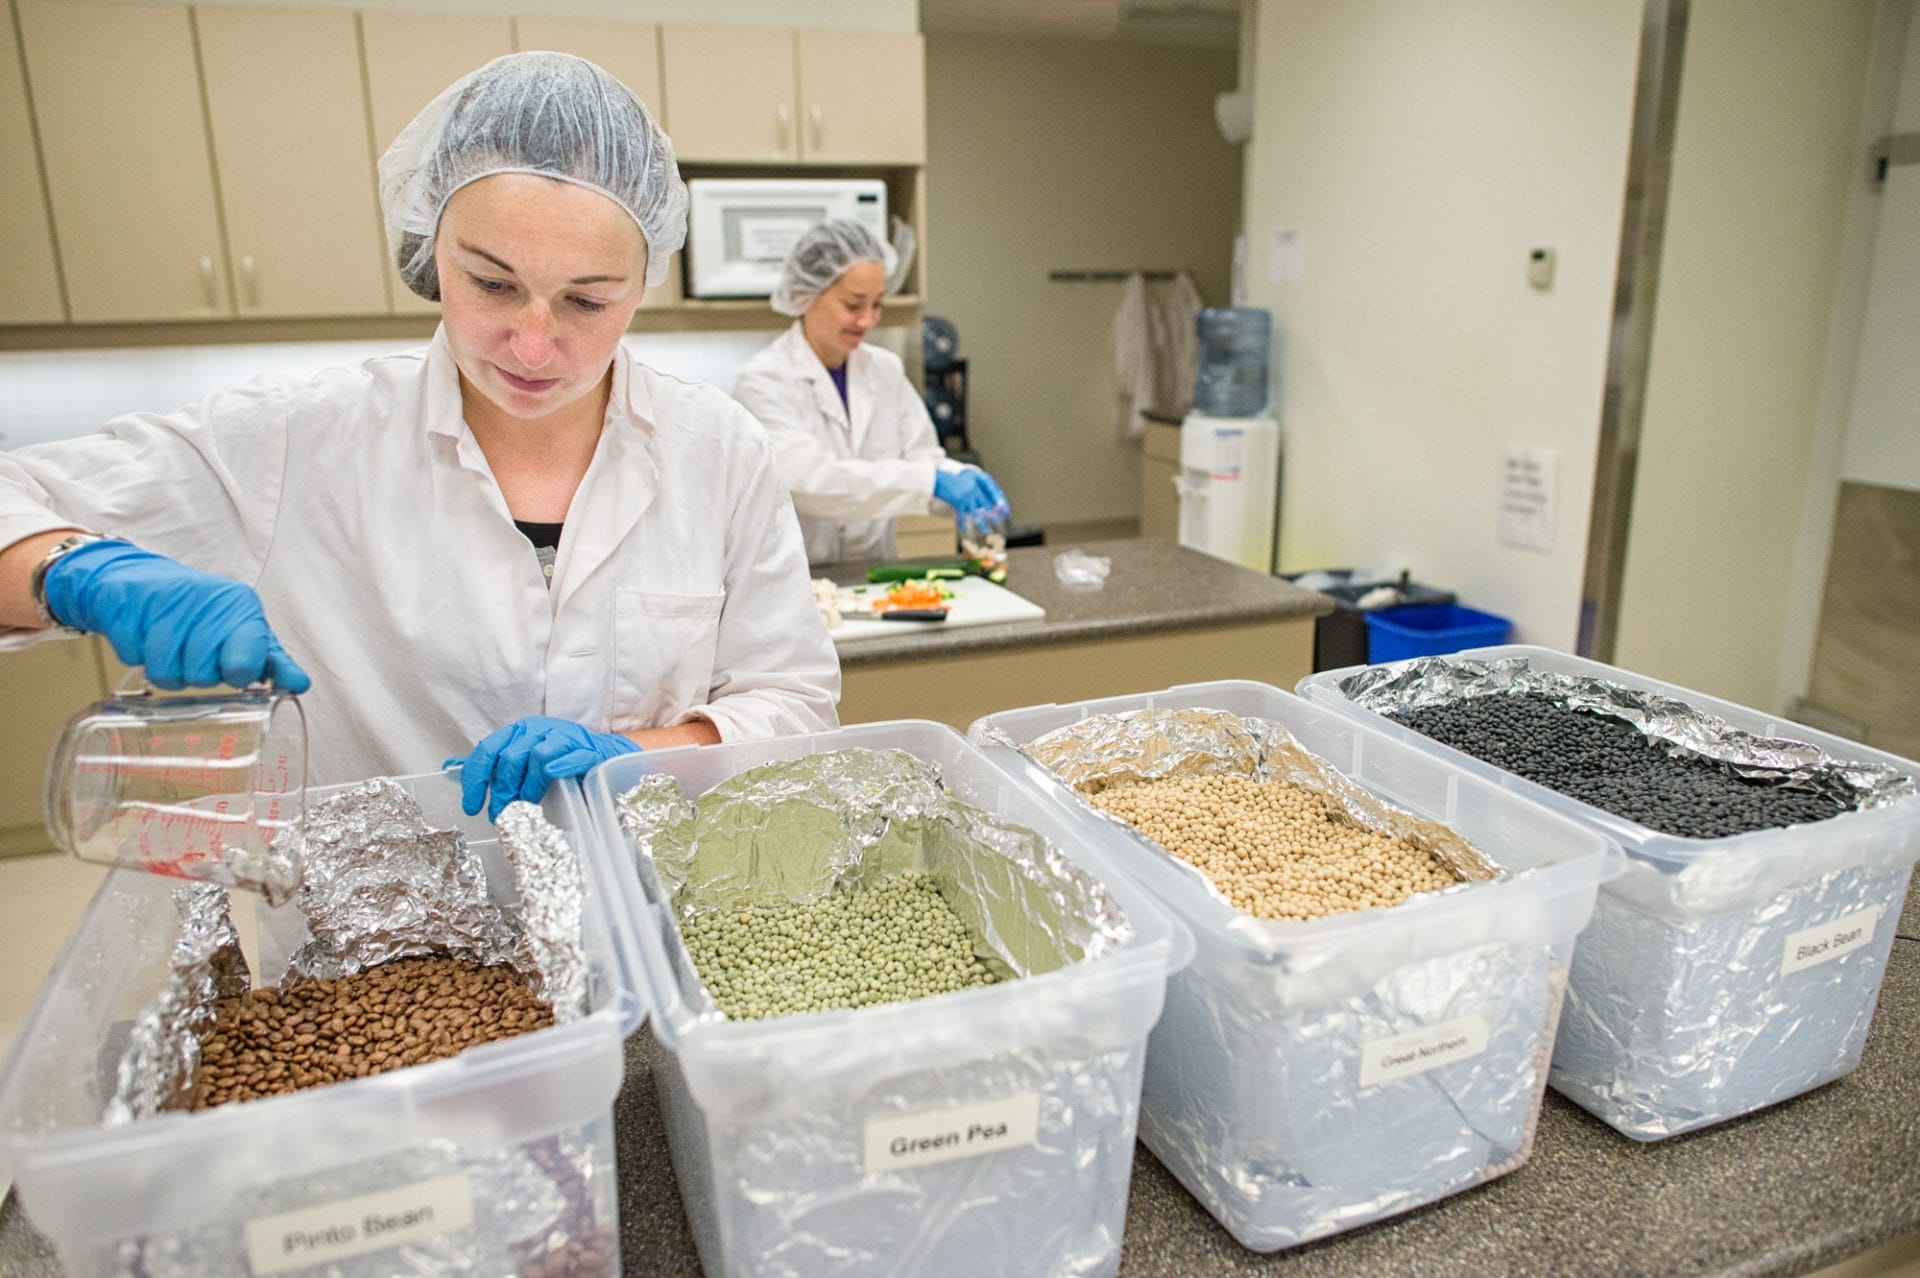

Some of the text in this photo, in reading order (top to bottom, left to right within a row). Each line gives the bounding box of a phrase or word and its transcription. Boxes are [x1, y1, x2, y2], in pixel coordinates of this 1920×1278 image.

[1797, 928, 1862, 960] Black Bean
[890, 1122, 1008, 1156] Green Pea
[283, 1206, 435, 1253] Pinto Bean
